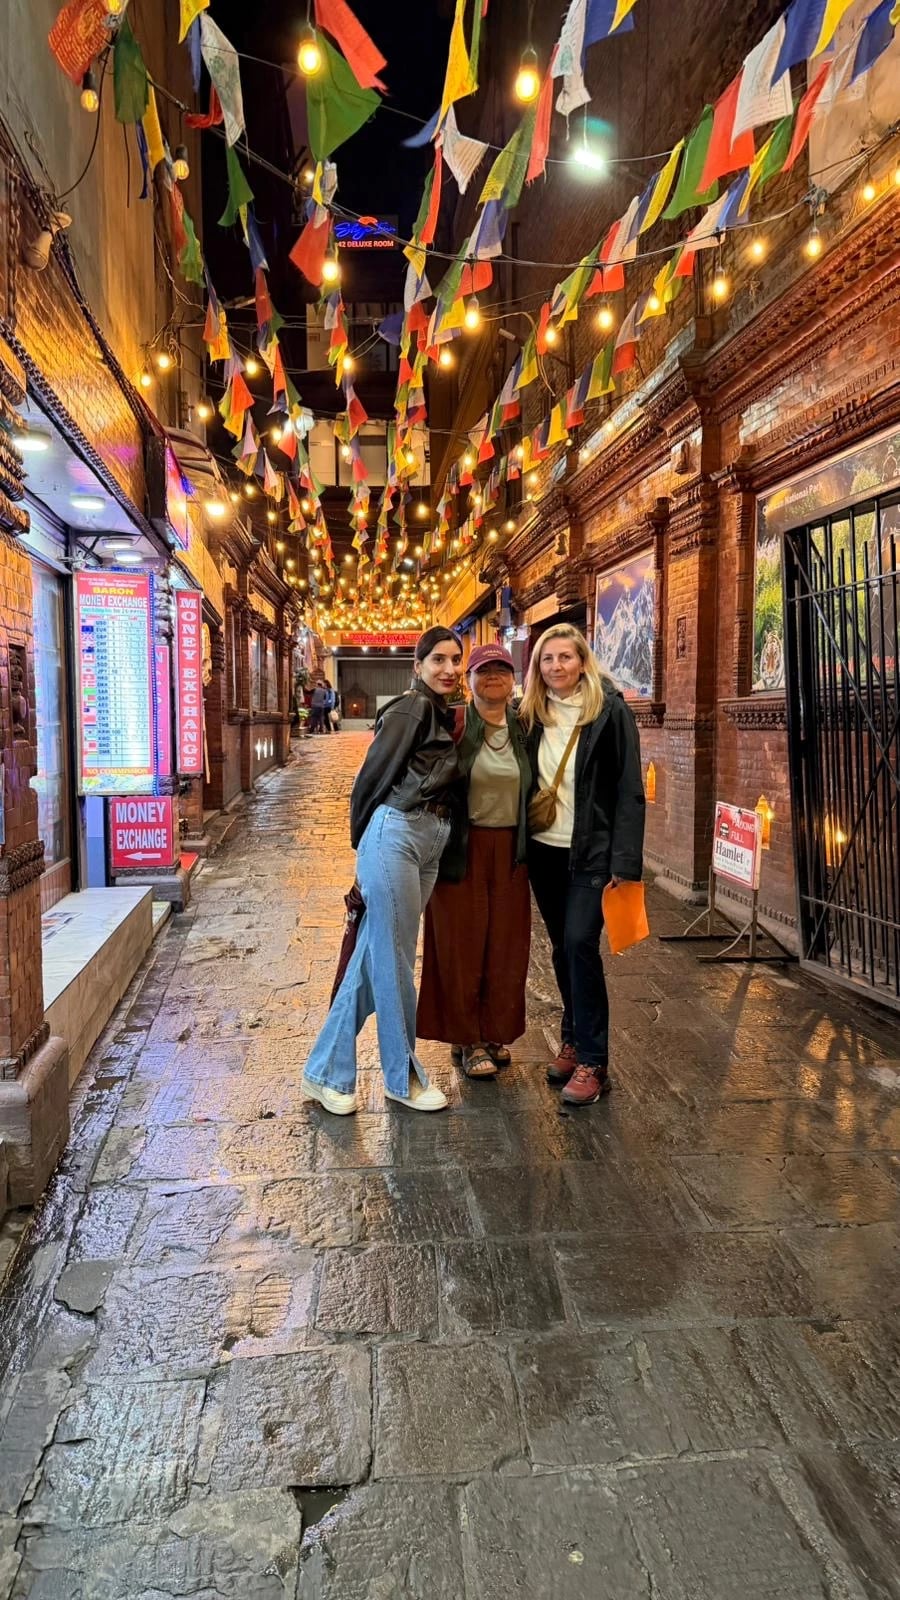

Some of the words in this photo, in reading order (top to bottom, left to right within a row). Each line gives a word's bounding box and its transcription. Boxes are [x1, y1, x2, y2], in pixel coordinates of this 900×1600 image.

[80, 594, 106, 606] MONEY
[108, 595, 148, 607] EXCHANGE
[92, 587, 134, 595] BARON
[179, 598, 197, 660] MONEY
[182, 667, 198, 767] EXCHANGE
[116, 802, 166, 823] MONEY
[731, 817, 755, 832] PARKING
[116, 828, 167, 850] EXCHANGE
[730, 831, 744, 843] FULL
[715, 840, 744, 864] Hamlet
